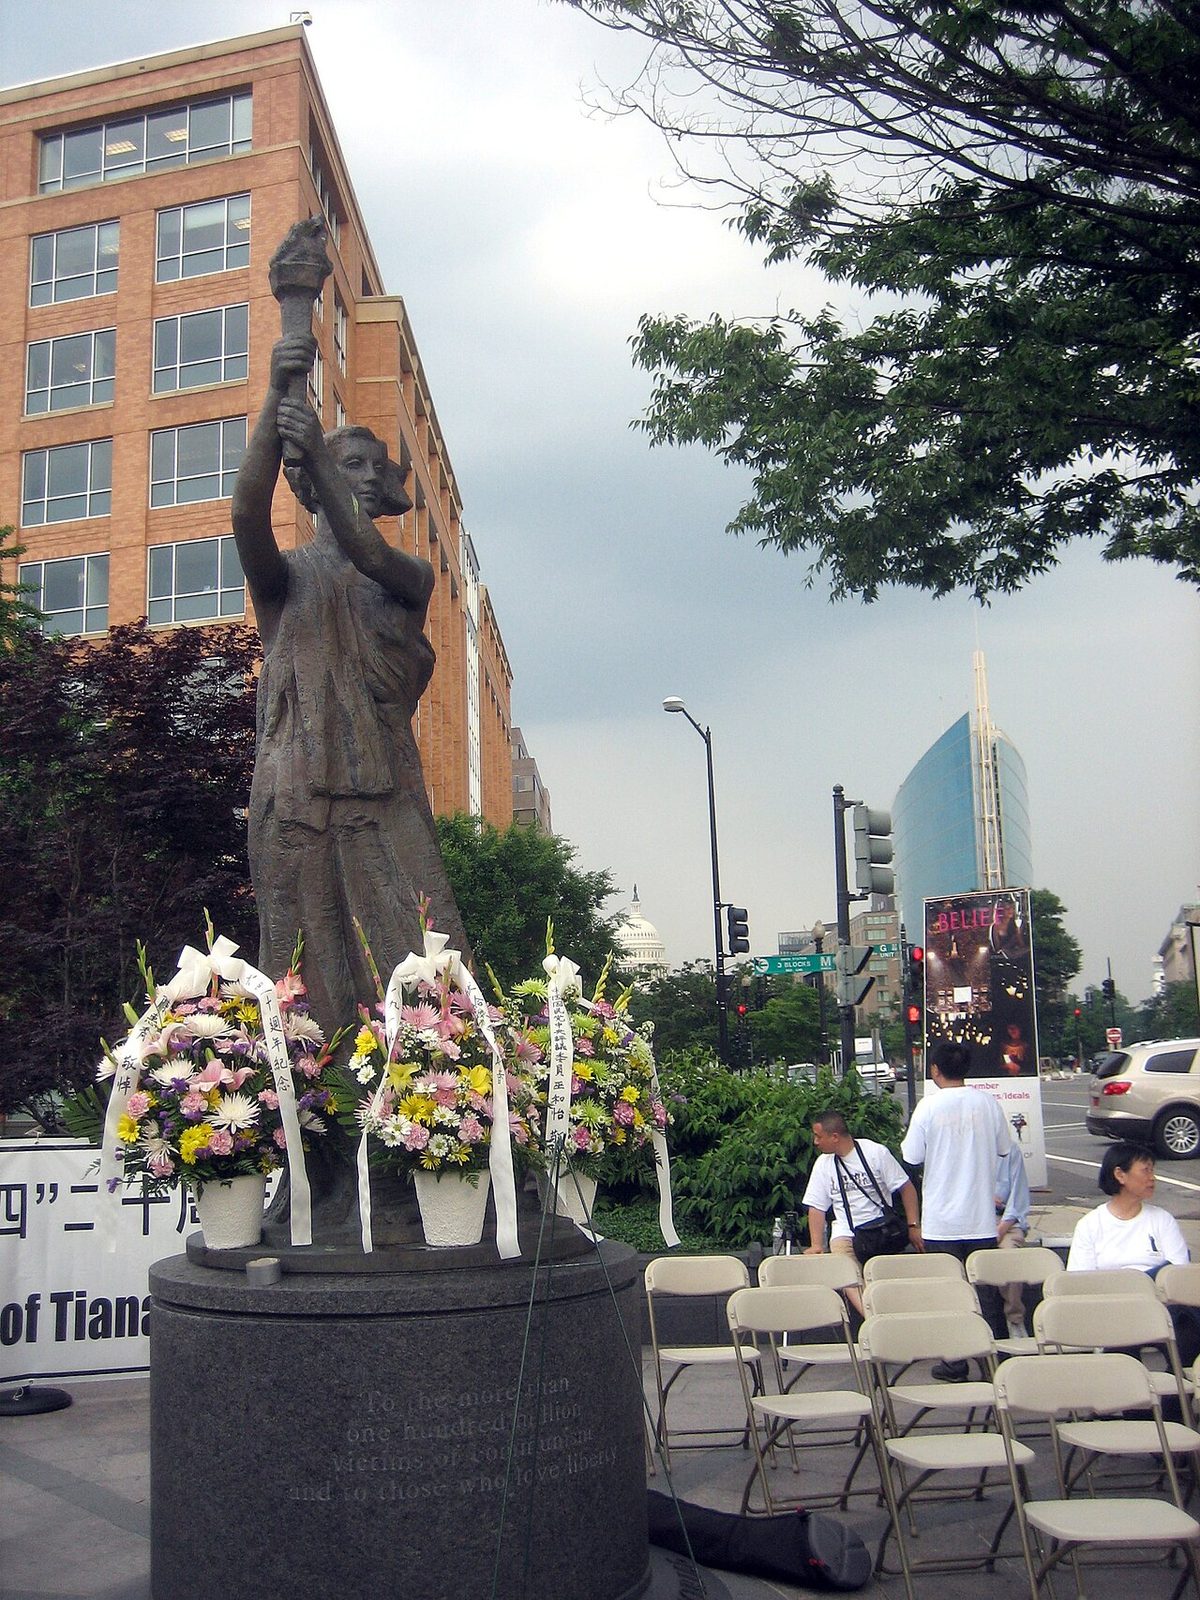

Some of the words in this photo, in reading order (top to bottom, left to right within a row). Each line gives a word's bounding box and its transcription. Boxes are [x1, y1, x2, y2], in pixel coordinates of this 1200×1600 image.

[938, 907, 1004, 932] BELIEF
[820, 956, 831, 966] M
[880, 944, 887, 952] G
[0, 1293, 41, 1346] of
[362, 1389, 395, 1413] To
[459, 1384, 517, 1407] more
[527, 1376, 569, 1398] than
[346, 1421, 390, 1443] one
[403, 1412, 505, 1440] hundred
[514, 1400, 582, 1429] million
[288, 1480, 331, 1502] and
[343, 1484, 367, 1502] to
[378, 1480, 448, 1502] those
[459, 1473, 507, 1495] who
[516, 1461, 560, 1487] love
[567, 1446, 617, 1476] liberty
[332, 1450, 424, 1473] victims
